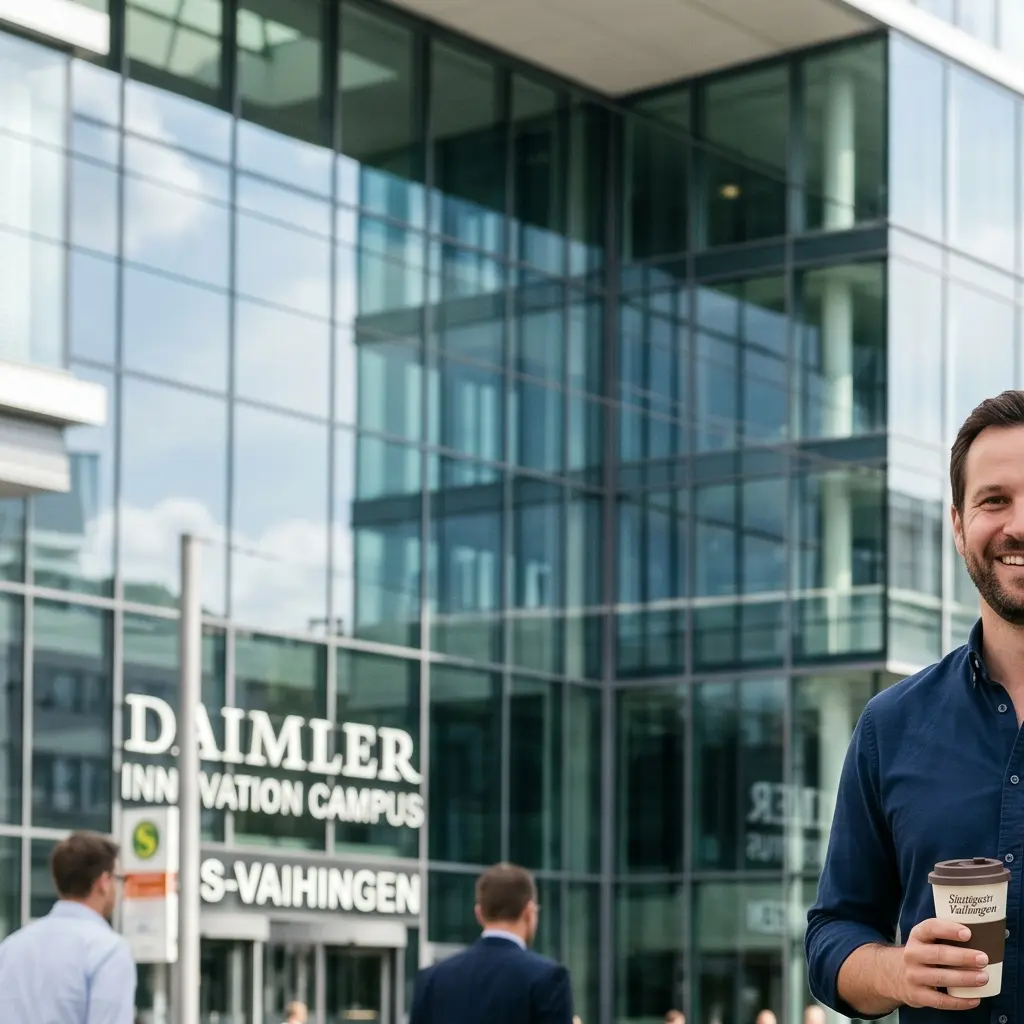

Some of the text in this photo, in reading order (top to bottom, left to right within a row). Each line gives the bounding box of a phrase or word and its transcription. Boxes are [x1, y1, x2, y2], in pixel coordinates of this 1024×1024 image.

[121, 763, 425, 829] INNVATION CAMPUS
[200, 858, 421, 914] S-VAIHINGEN
